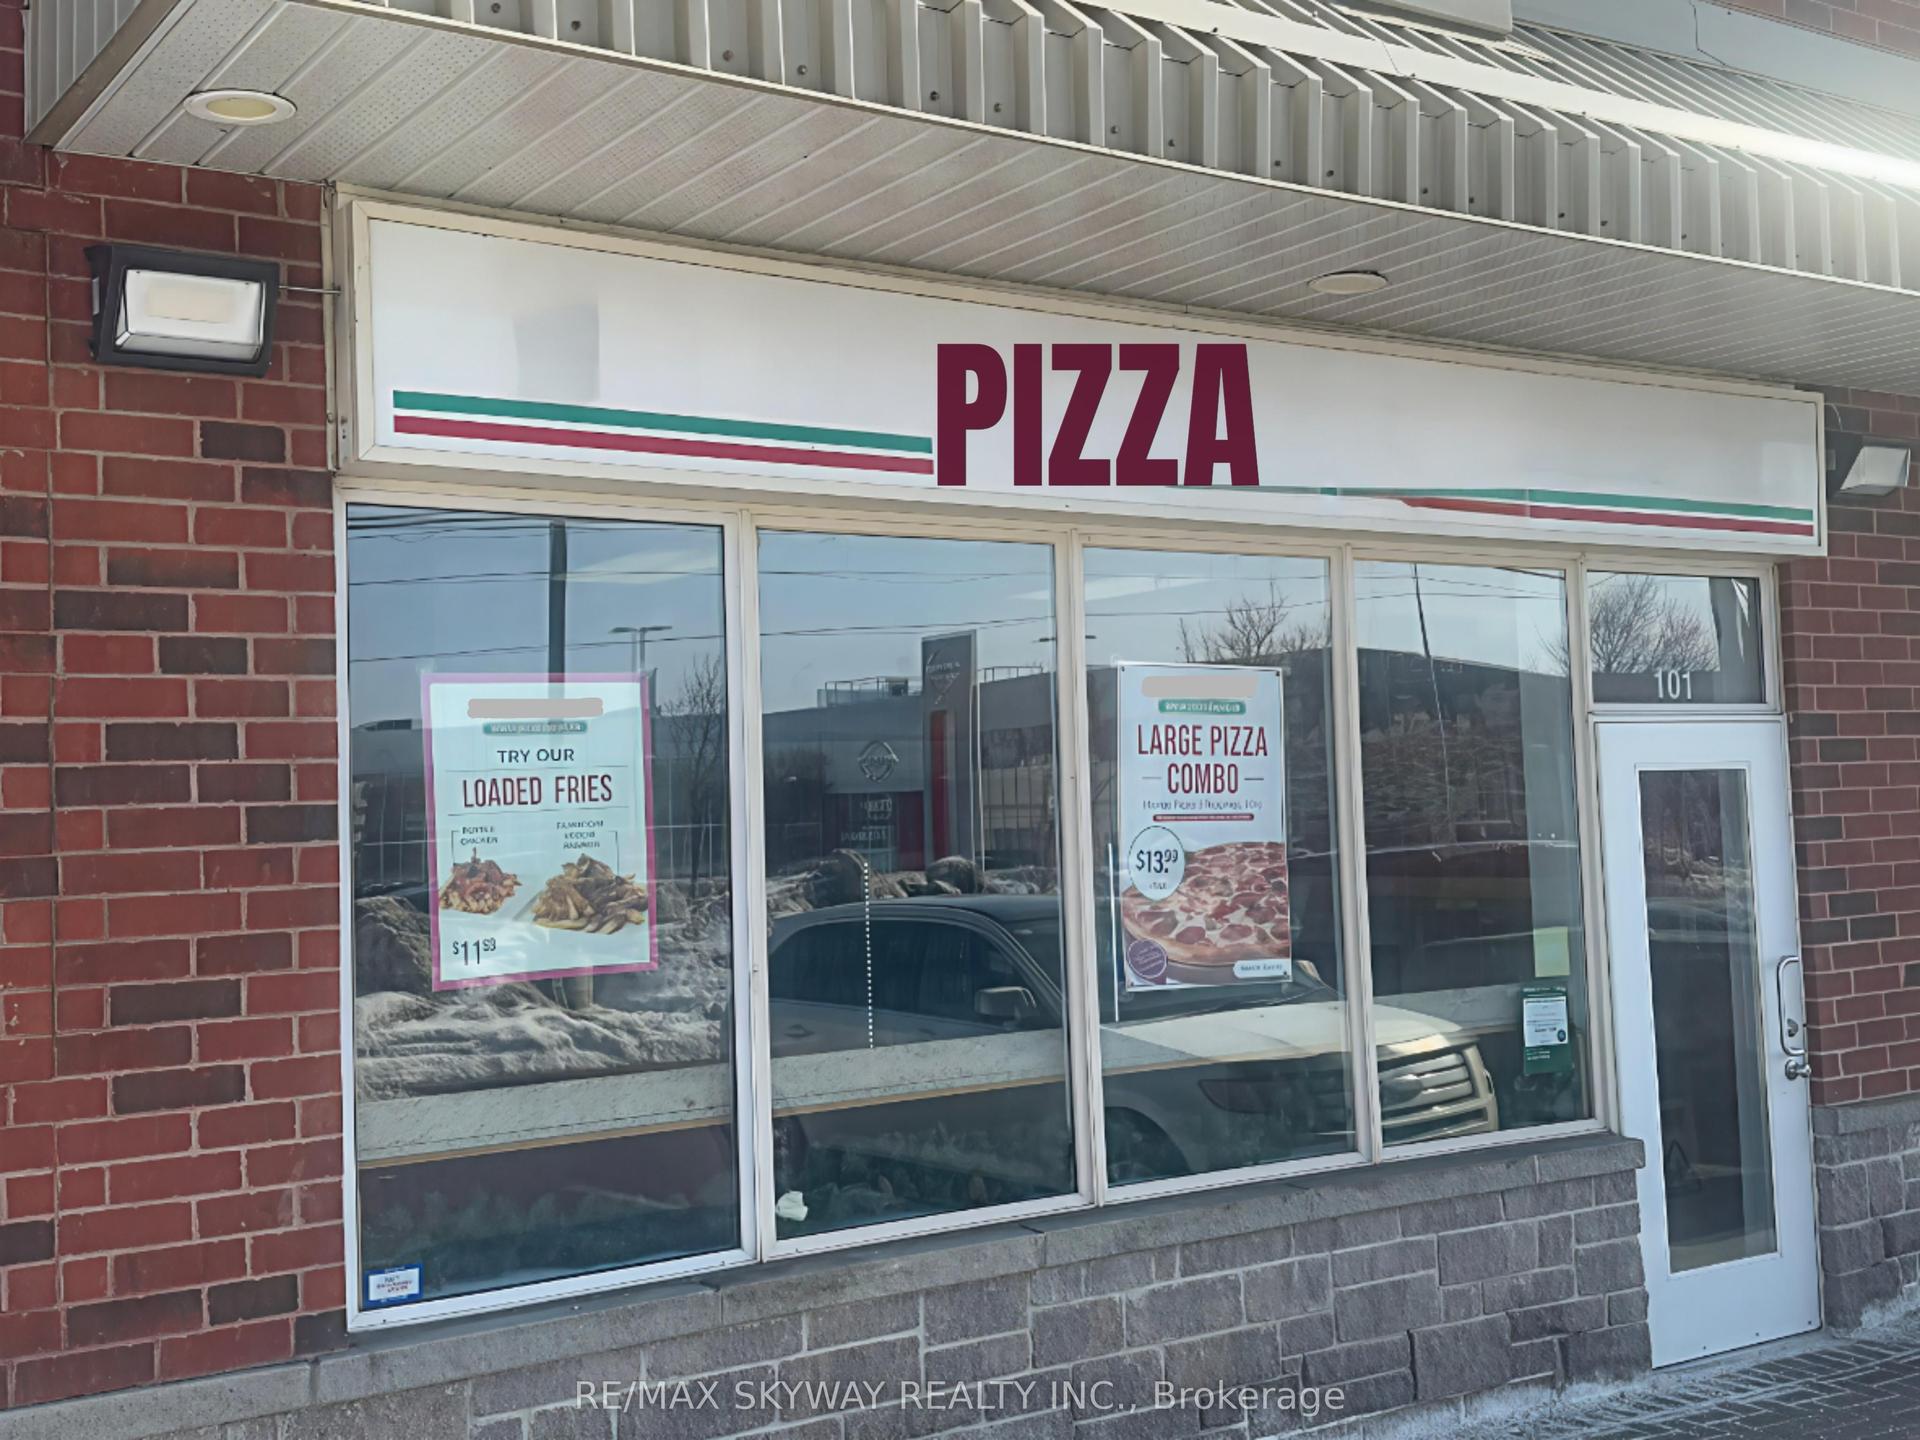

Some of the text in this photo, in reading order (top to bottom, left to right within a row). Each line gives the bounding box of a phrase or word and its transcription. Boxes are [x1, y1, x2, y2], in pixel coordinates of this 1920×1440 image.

[937, 343, 1260, 486] PIZZA
[1653, 668, 1692, 700] 101
[497, 748, 575, 764] TRY OUR
[1137, 724, 1268, 757] LARGE PIZZA
[462, 774, 613, 808] LOADED FRIES
[1167, 763, 1239, 794] COMBO
